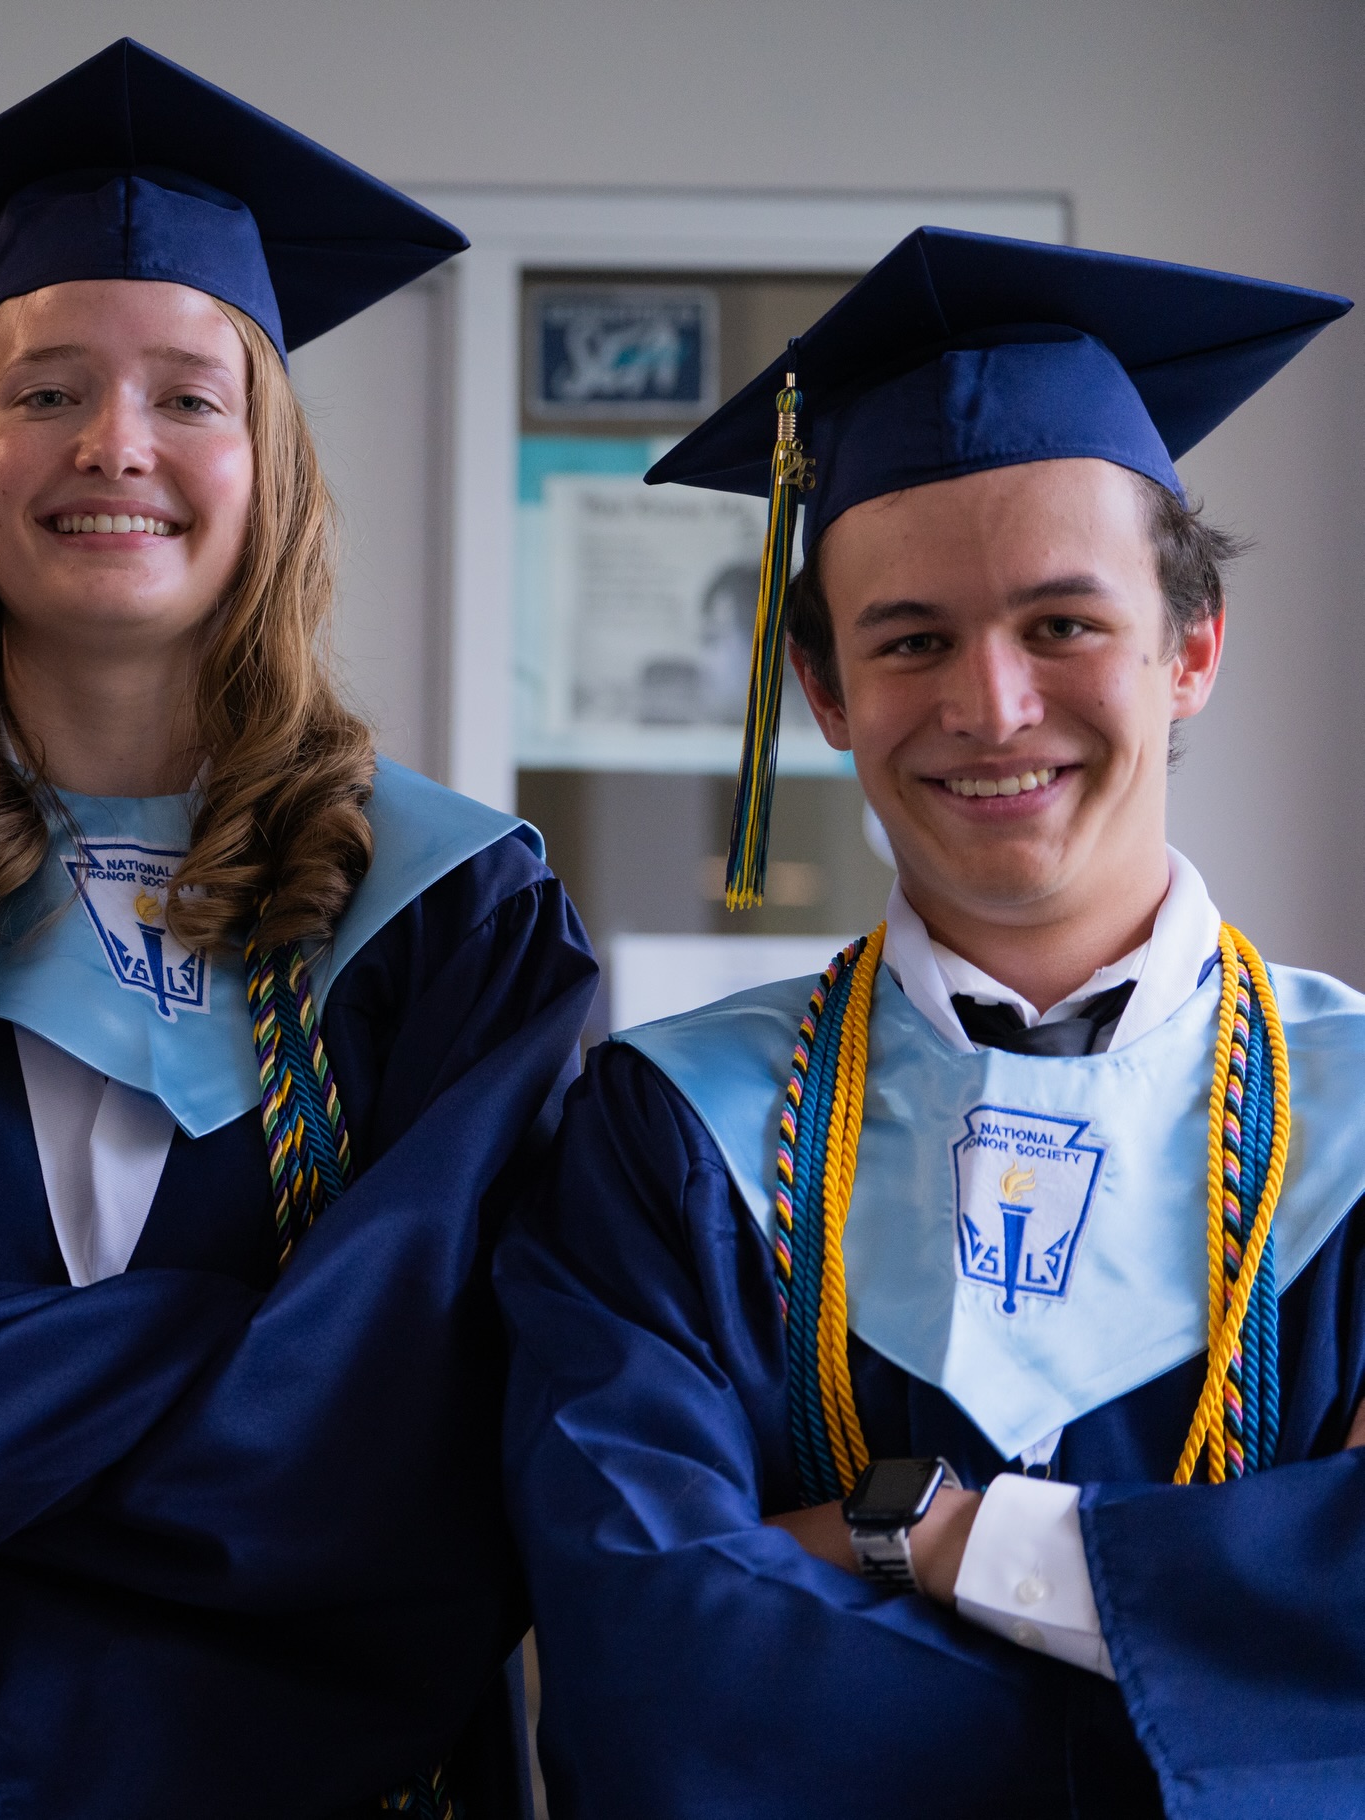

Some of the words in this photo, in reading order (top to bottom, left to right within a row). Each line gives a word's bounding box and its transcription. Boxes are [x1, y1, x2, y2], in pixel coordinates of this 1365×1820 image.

[778, 449, 816, 492] 26
[88, 869, 137, 883] HONOR
[140, 875, 195, 892] SOCY
[106, 859, 174, 877] NATIONAL
[980, 1122, 1058, 1147] NATIONAL
[962, 1136, 1009, 1154] HONOR
[1016, 1143, 1081, 1165] SOCIETY
